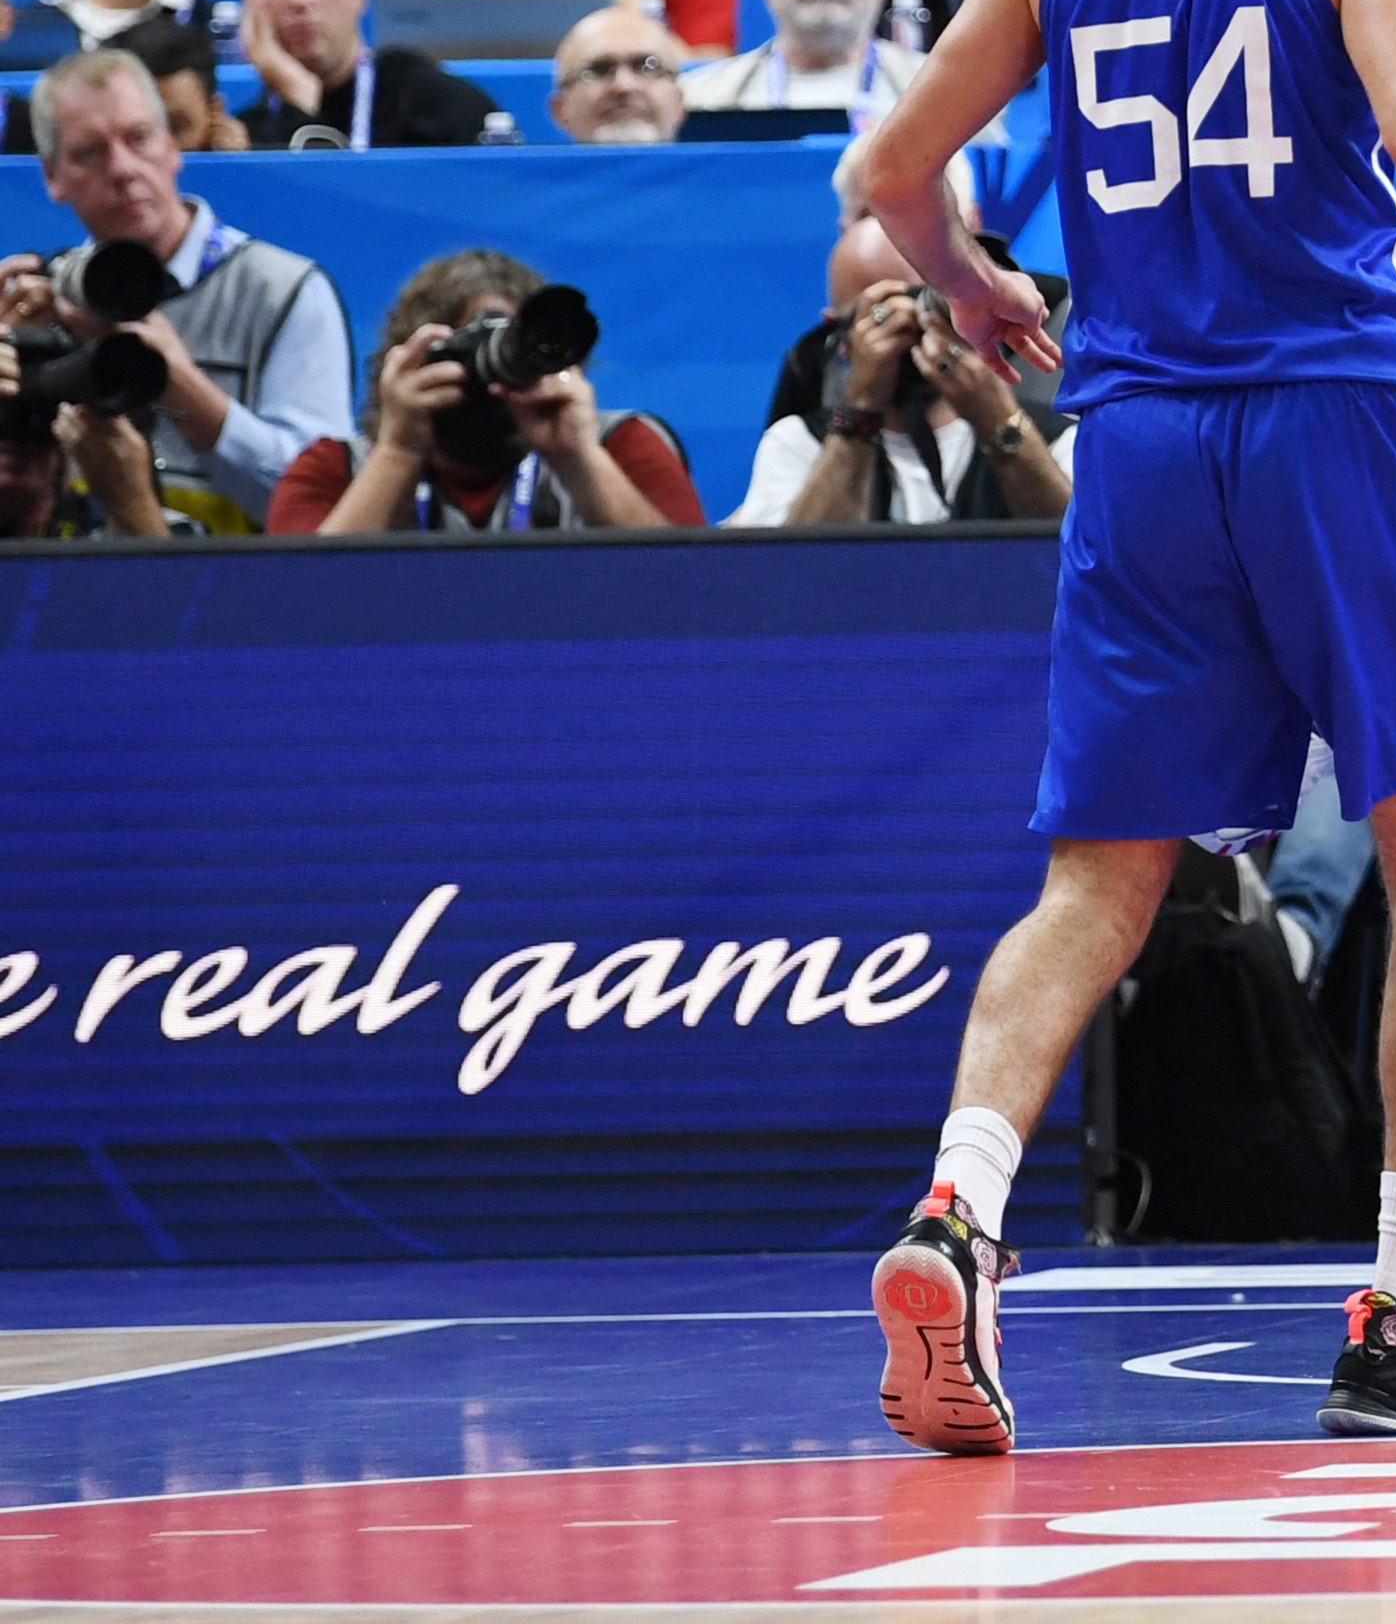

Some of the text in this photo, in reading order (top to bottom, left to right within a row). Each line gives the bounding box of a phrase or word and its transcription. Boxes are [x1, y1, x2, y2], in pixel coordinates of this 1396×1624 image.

[1070, 5, 1294, 214] 54
[74, 884, 460, 1043] real
[457, 932, 951, 1096] game
